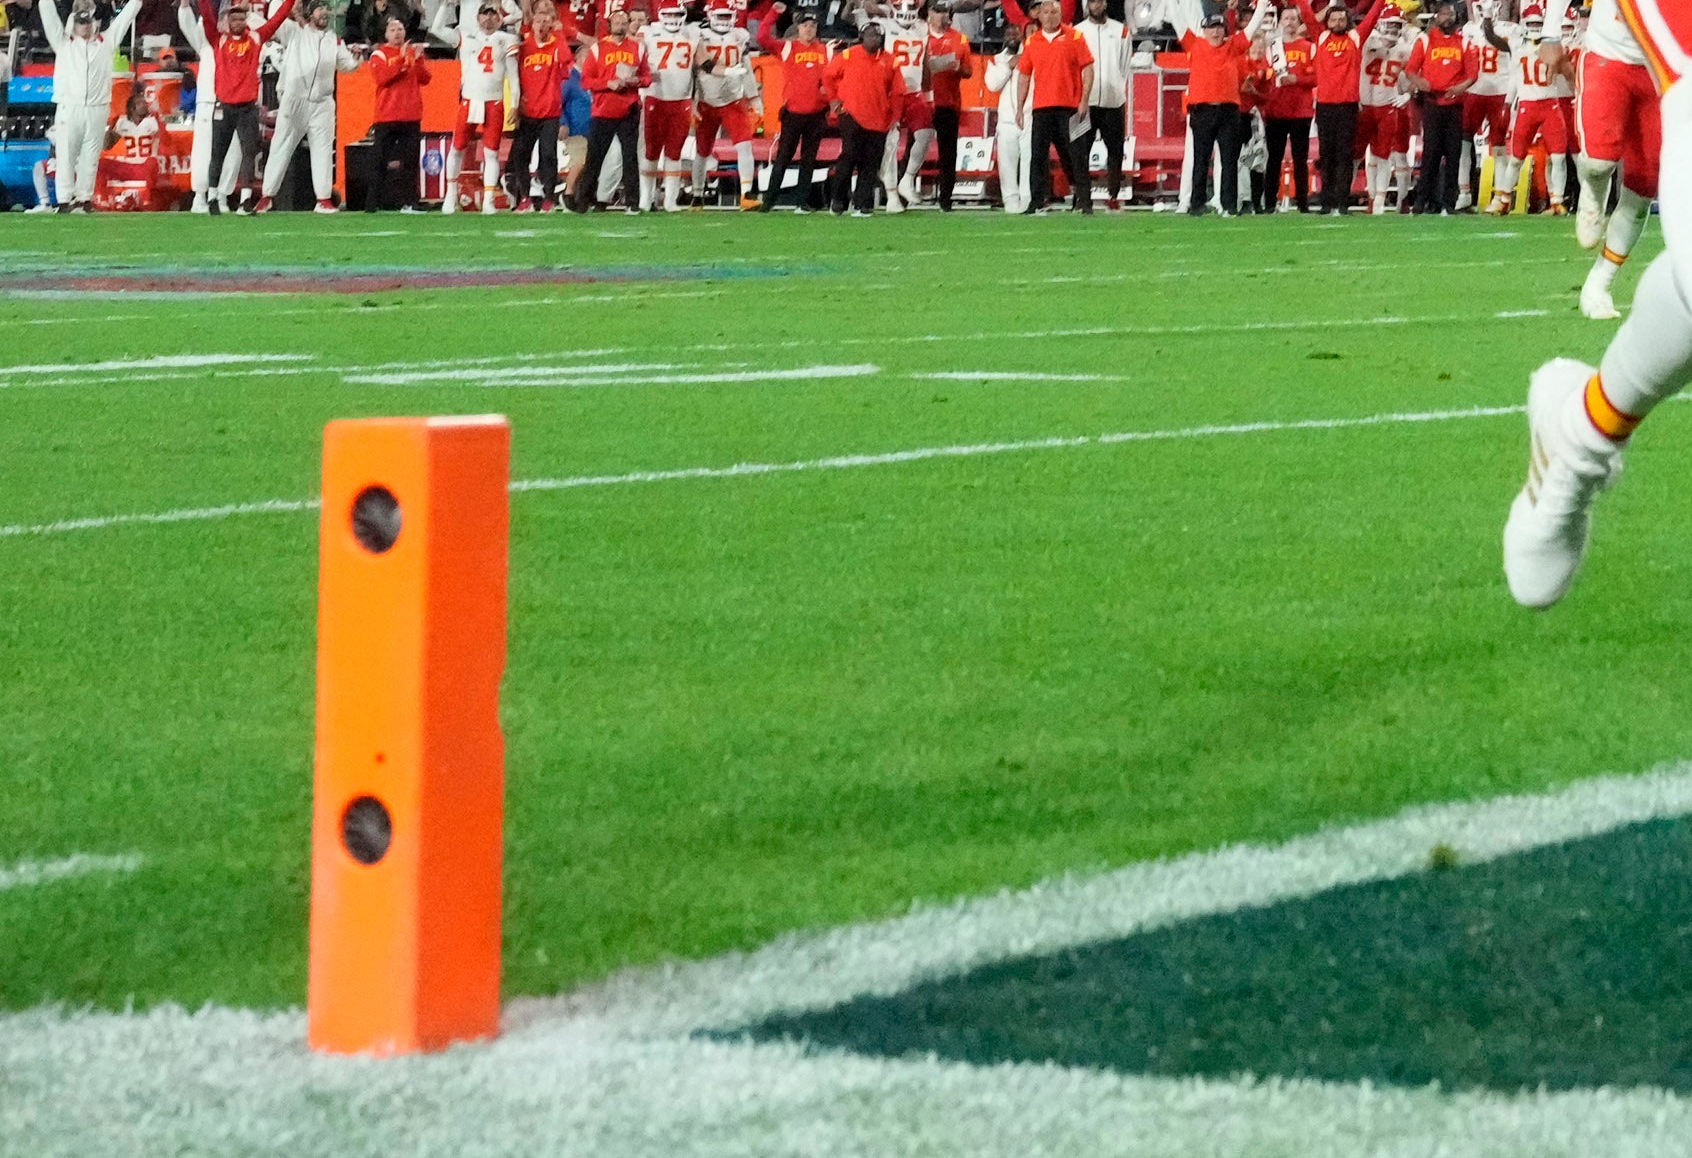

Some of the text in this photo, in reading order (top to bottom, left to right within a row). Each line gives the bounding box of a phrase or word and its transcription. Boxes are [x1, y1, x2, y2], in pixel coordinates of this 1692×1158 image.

[477, 46, 493, 73] 4
[657, 42, 691, 69] 73
[706, 45, 739, 67] 70
[1365, 60, 1401, 88] 45
[1520, 56, 1549, 86] 10
